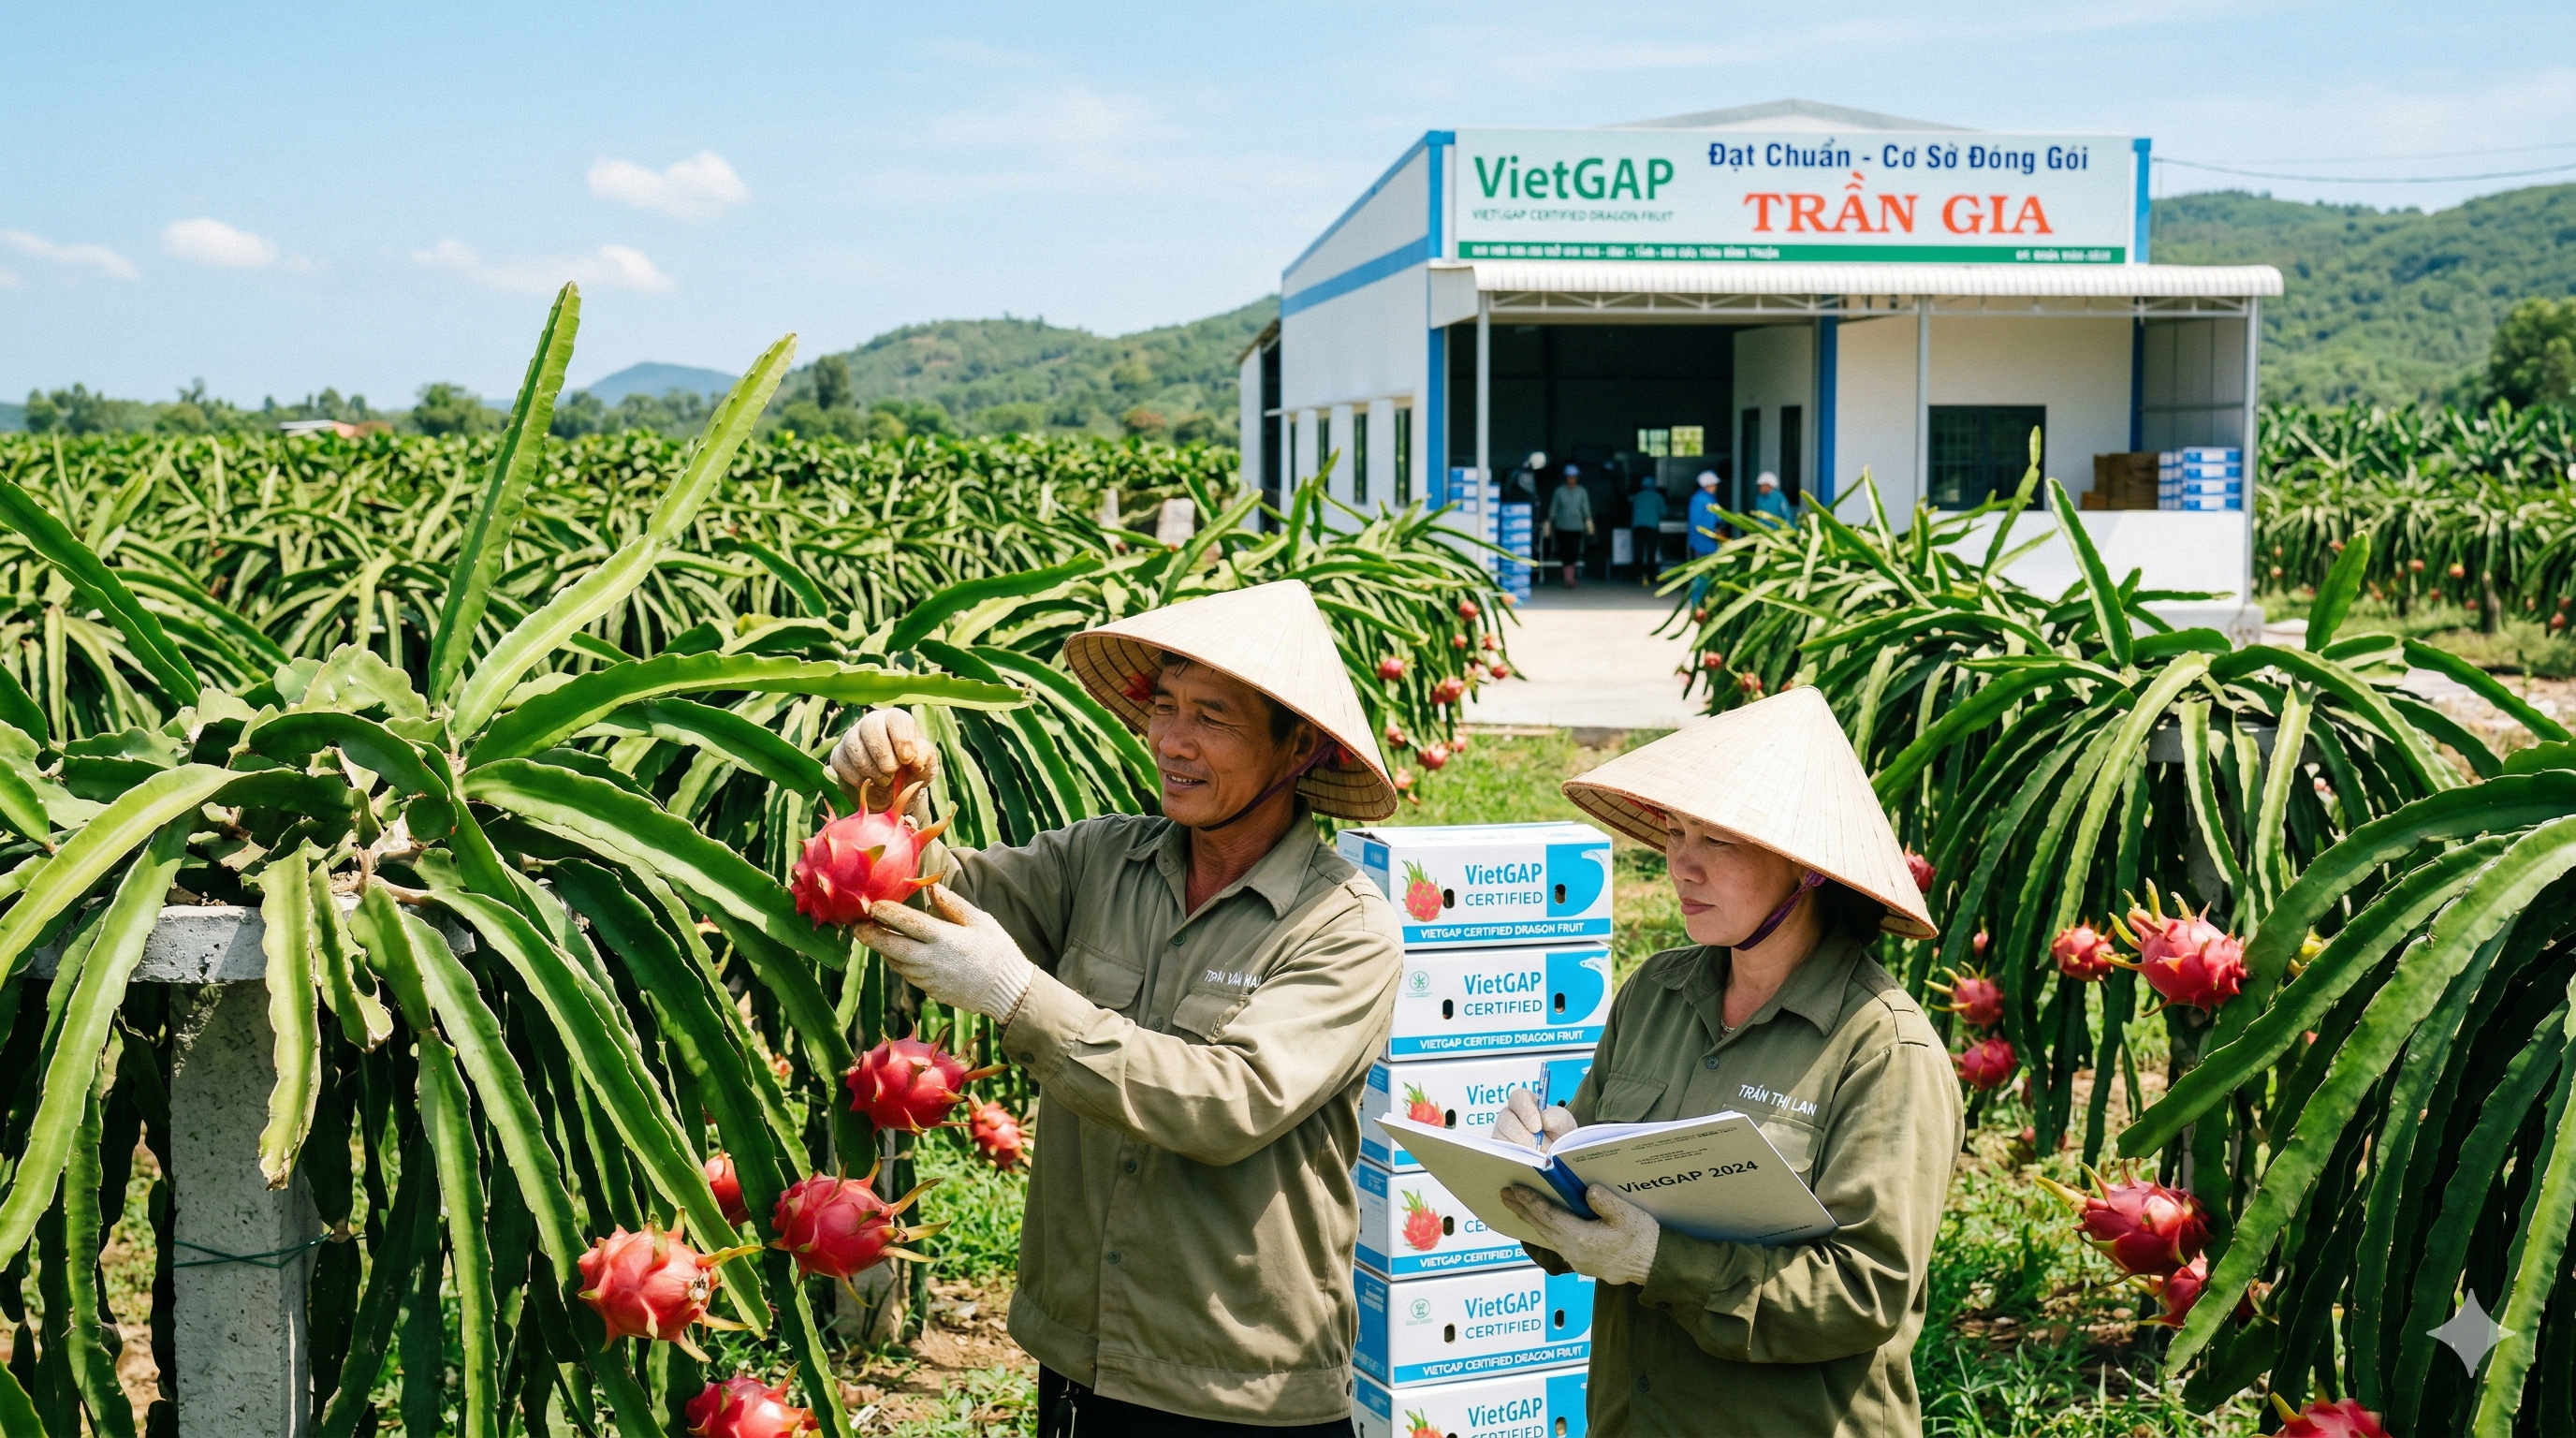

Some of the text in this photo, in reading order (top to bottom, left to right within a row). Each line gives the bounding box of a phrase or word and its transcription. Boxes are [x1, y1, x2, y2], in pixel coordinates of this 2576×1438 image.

[1709, 142, 1754, 172] Đạt
[1883, 144, 1917, 169] Cơ
[1969, 145, 2035, 175] Đóng
[2048, 144, 2087, 169] Gói
[1474, 155, 1674, 200] VietGAP
[1743, 170, 2054, 234] TRẦN GIA
[1465, 863, 1543, 886] VietGAP
[1465, 891, 1543, 906] CERTIFIED
[1421, 928, 1462, 939] VIETGAP
[1464, 925, 1513, 937] CERTIFIED
[1558, 922, 1585, 933] FRUIT
[1464, 972, 1542, 995] VietGAP
[1464, 1000, 1543, 1016] CERTIFIED
[1420, 1030, 1585, 1049] VIETGAP CERTIFIED DRAGON FRUIT
[1791, 1097, 1818, 1117] LAN
[1617, 1160, 1759, 1194] VietGAP 2024
[1465, 1290, 1542, 1319] VietGAP
[1465, 1318, 1542, 1339] CERTIFIED
[1468, 1397, 1543, 1428] VietGAP
